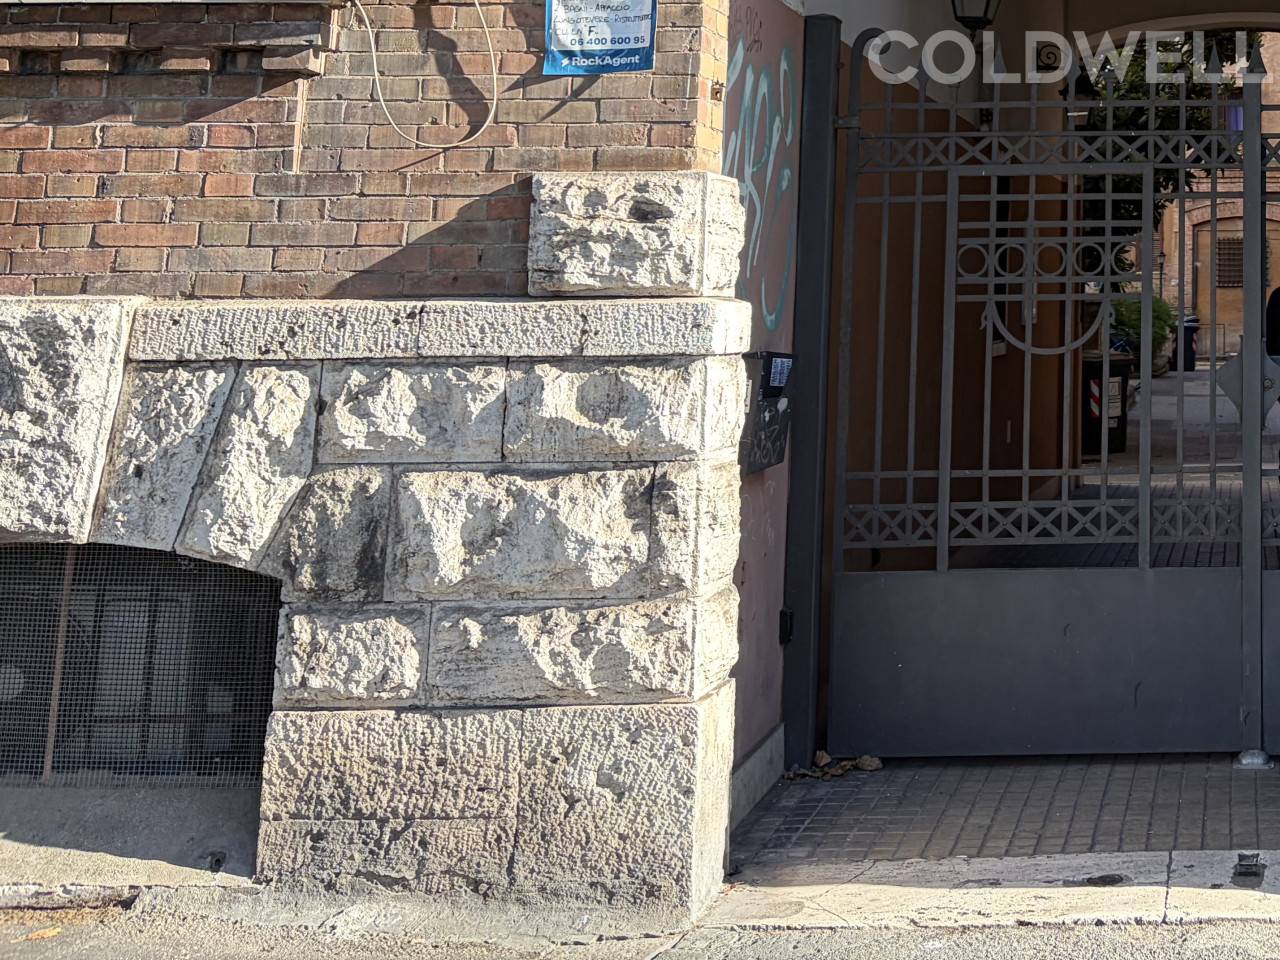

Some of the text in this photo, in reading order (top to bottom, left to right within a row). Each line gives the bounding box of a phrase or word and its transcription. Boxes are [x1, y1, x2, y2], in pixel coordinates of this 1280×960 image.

[586, 38, 607, 46] 400
[610, 37, 631, 45] 600
[633, 36, 645, 44] 95
[572, 54, 640, 67] RockAgent
